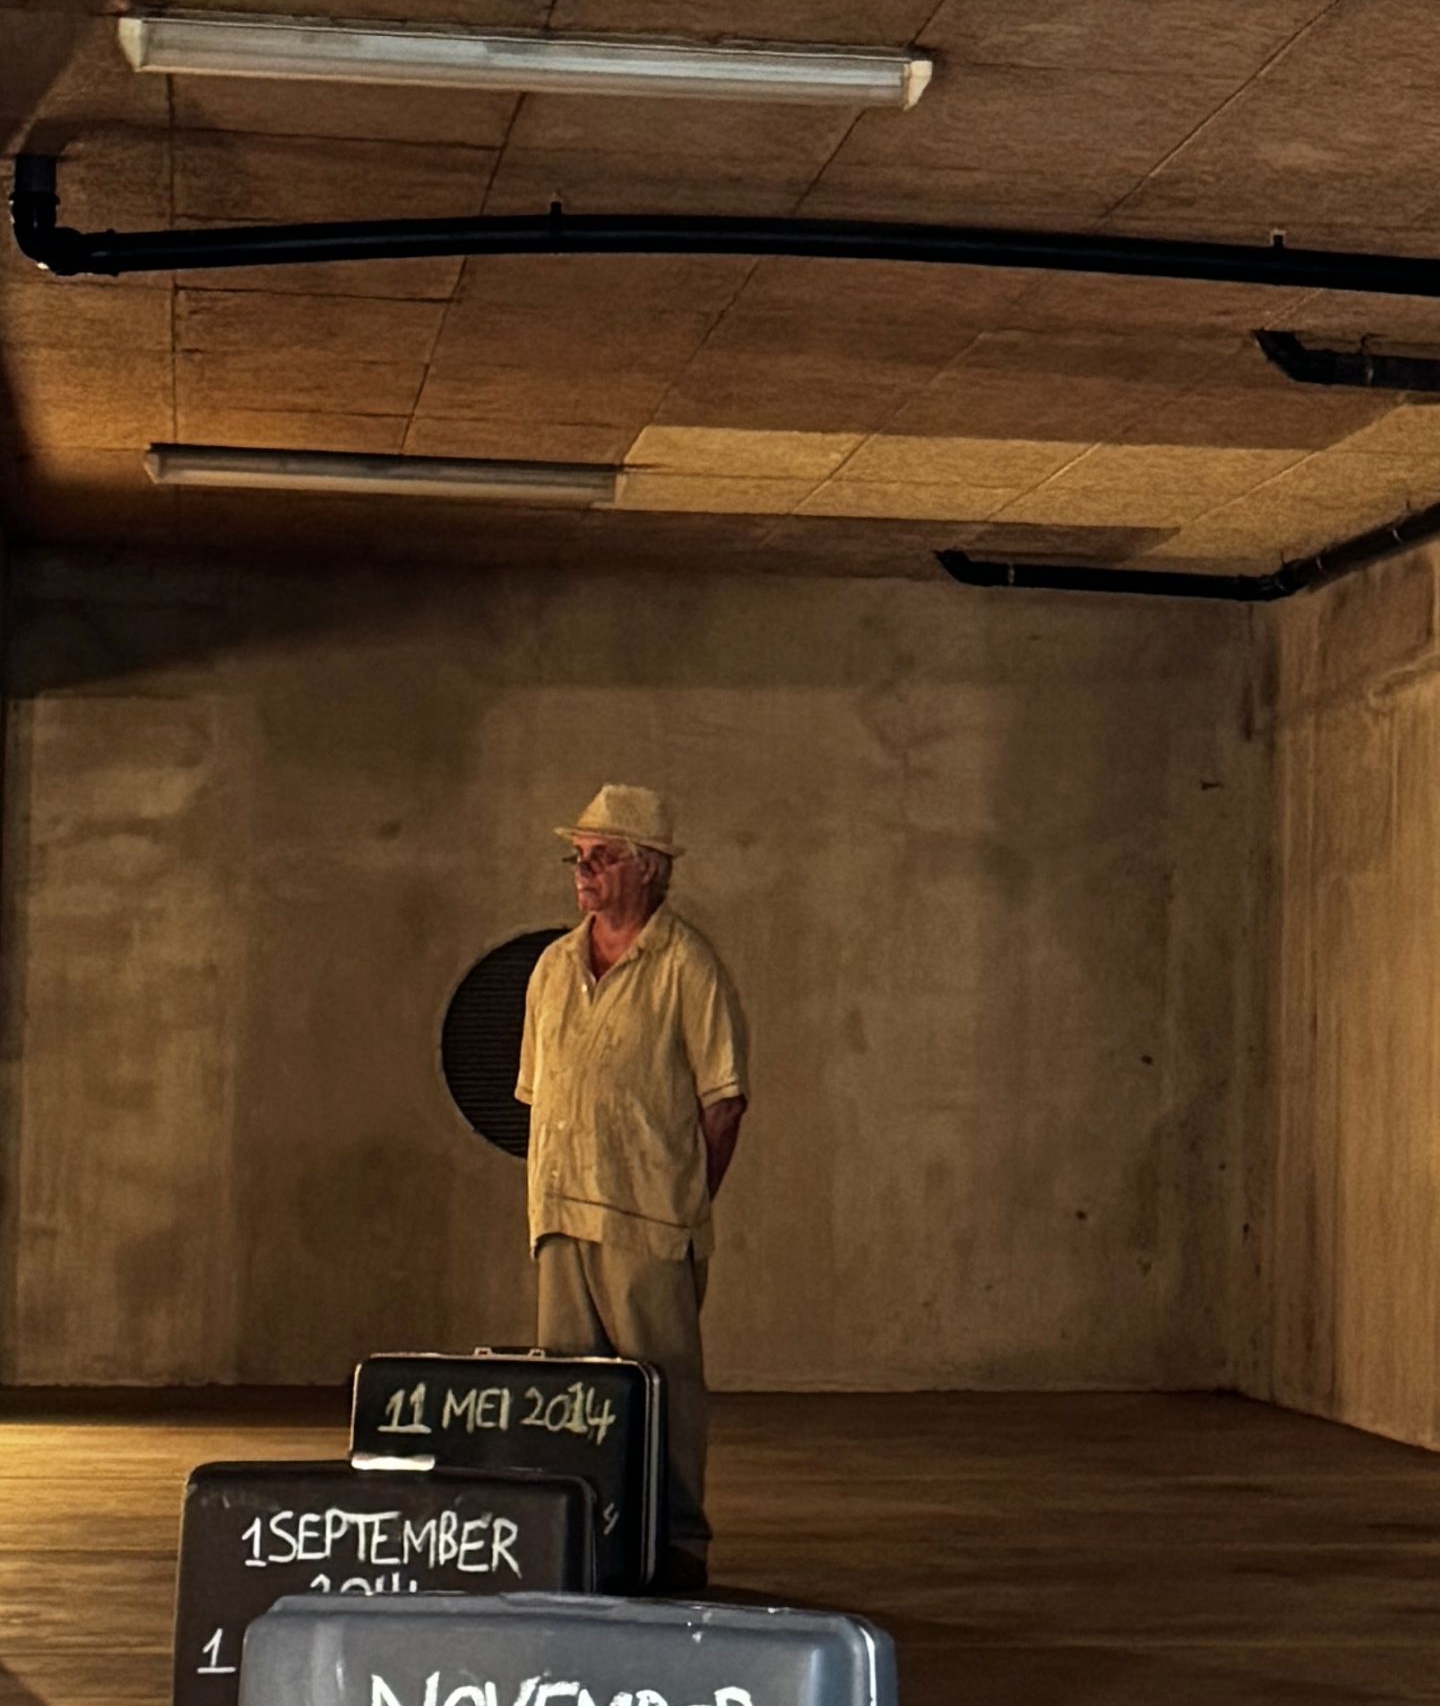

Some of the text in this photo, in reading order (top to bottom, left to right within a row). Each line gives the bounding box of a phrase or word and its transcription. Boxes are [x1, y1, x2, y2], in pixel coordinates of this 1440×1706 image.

[377, 1381, 616, 1445] 11 MEI 2014
